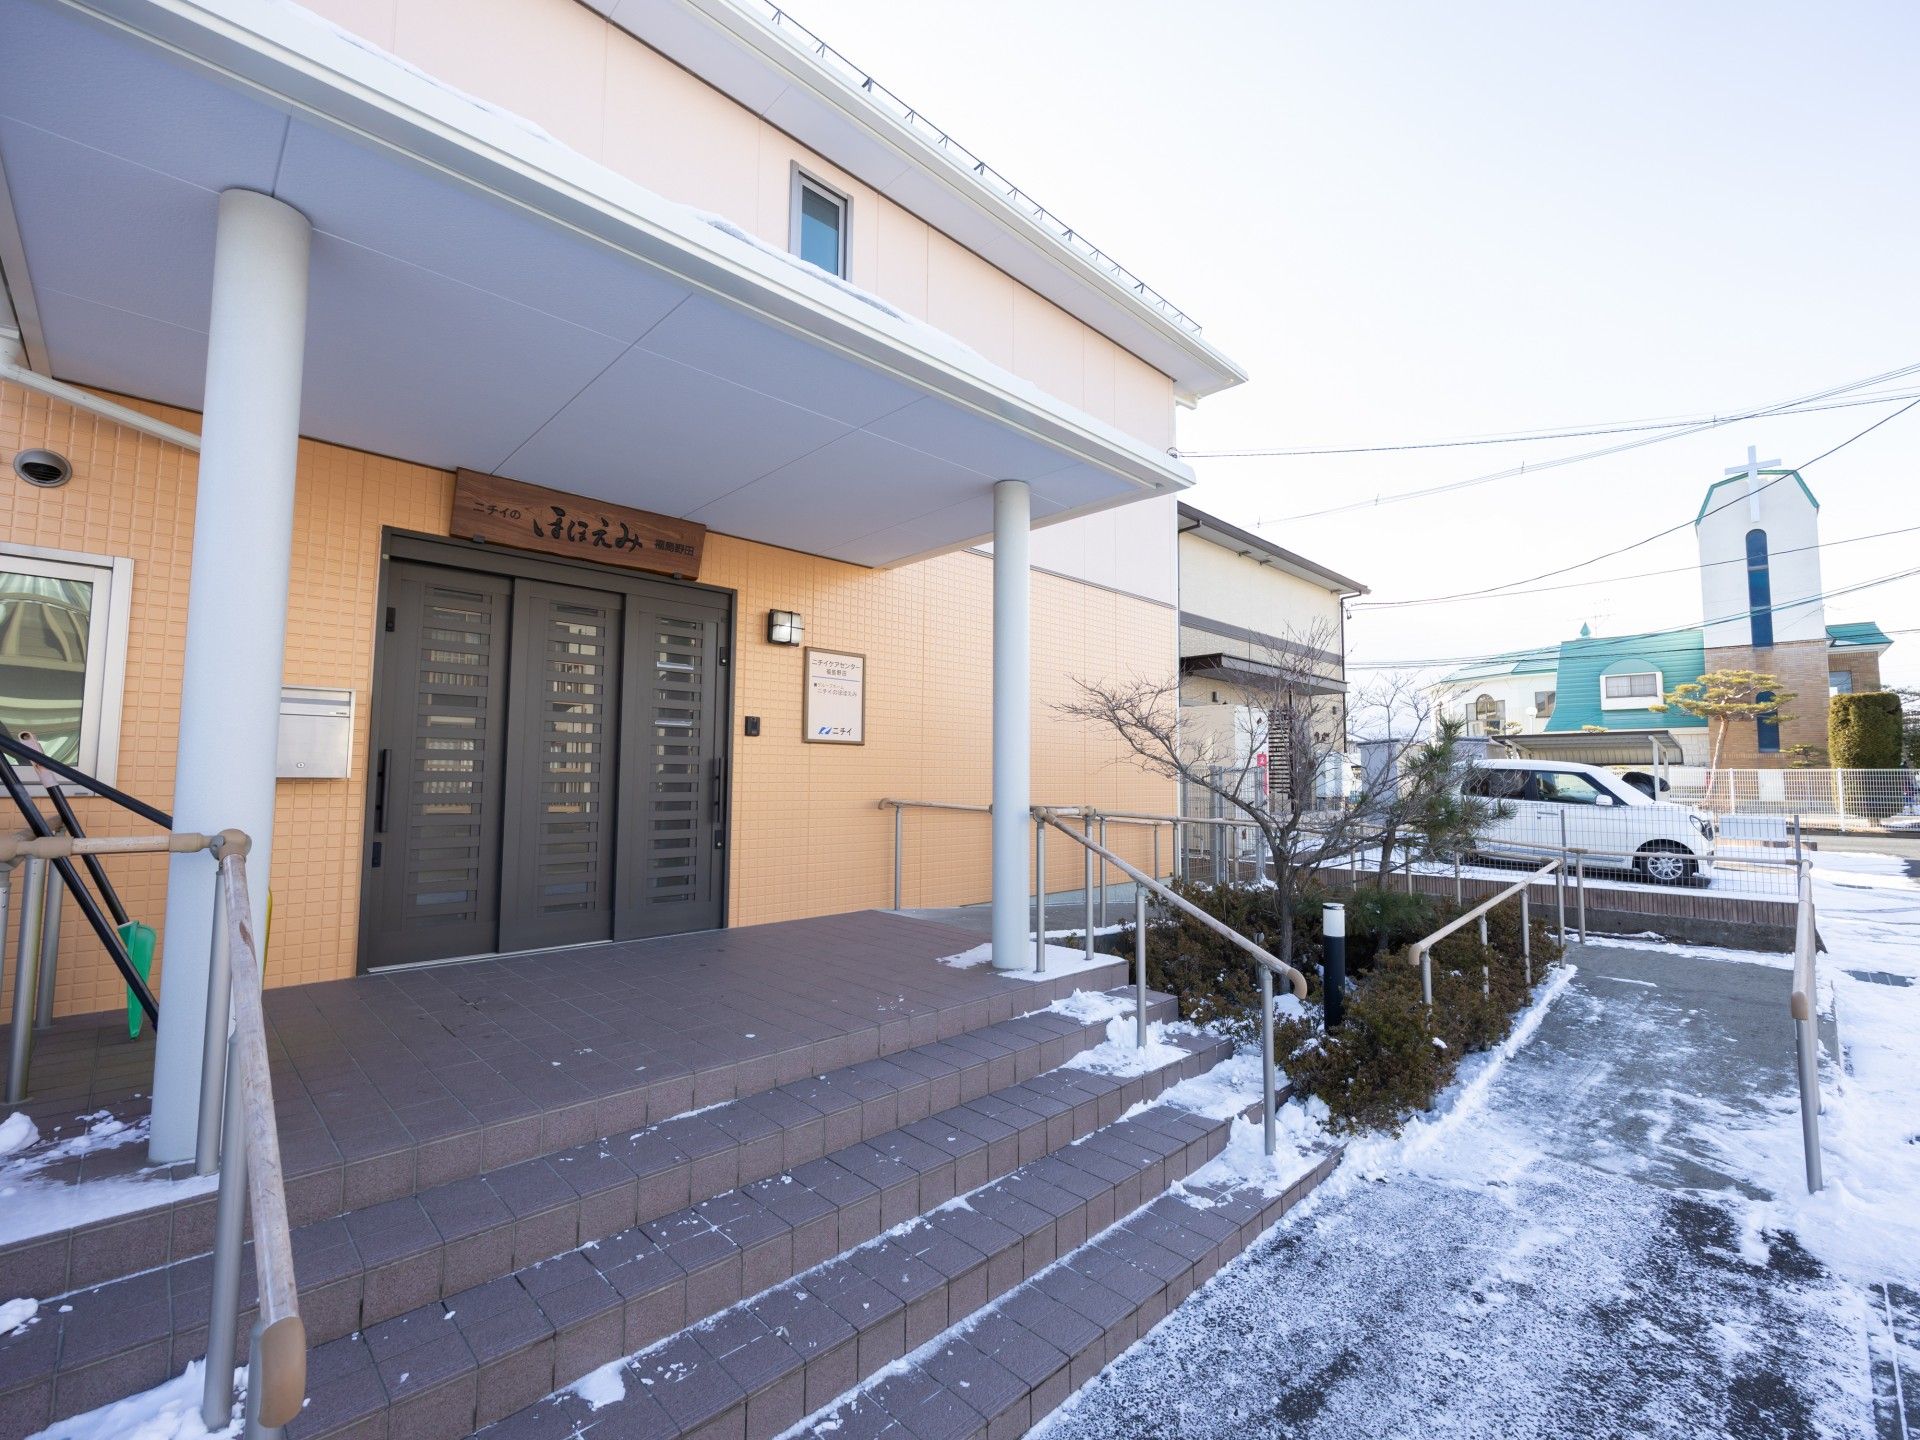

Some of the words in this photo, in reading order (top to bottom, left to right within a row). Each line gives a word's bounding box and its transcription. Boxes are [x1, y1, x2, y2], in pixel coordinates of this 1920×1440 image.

[473, 501, 521, 520] ニチイの
[812, 659, 860, 670] ニチイケアセンター
[833, 727, 853, 736] ニチイ
